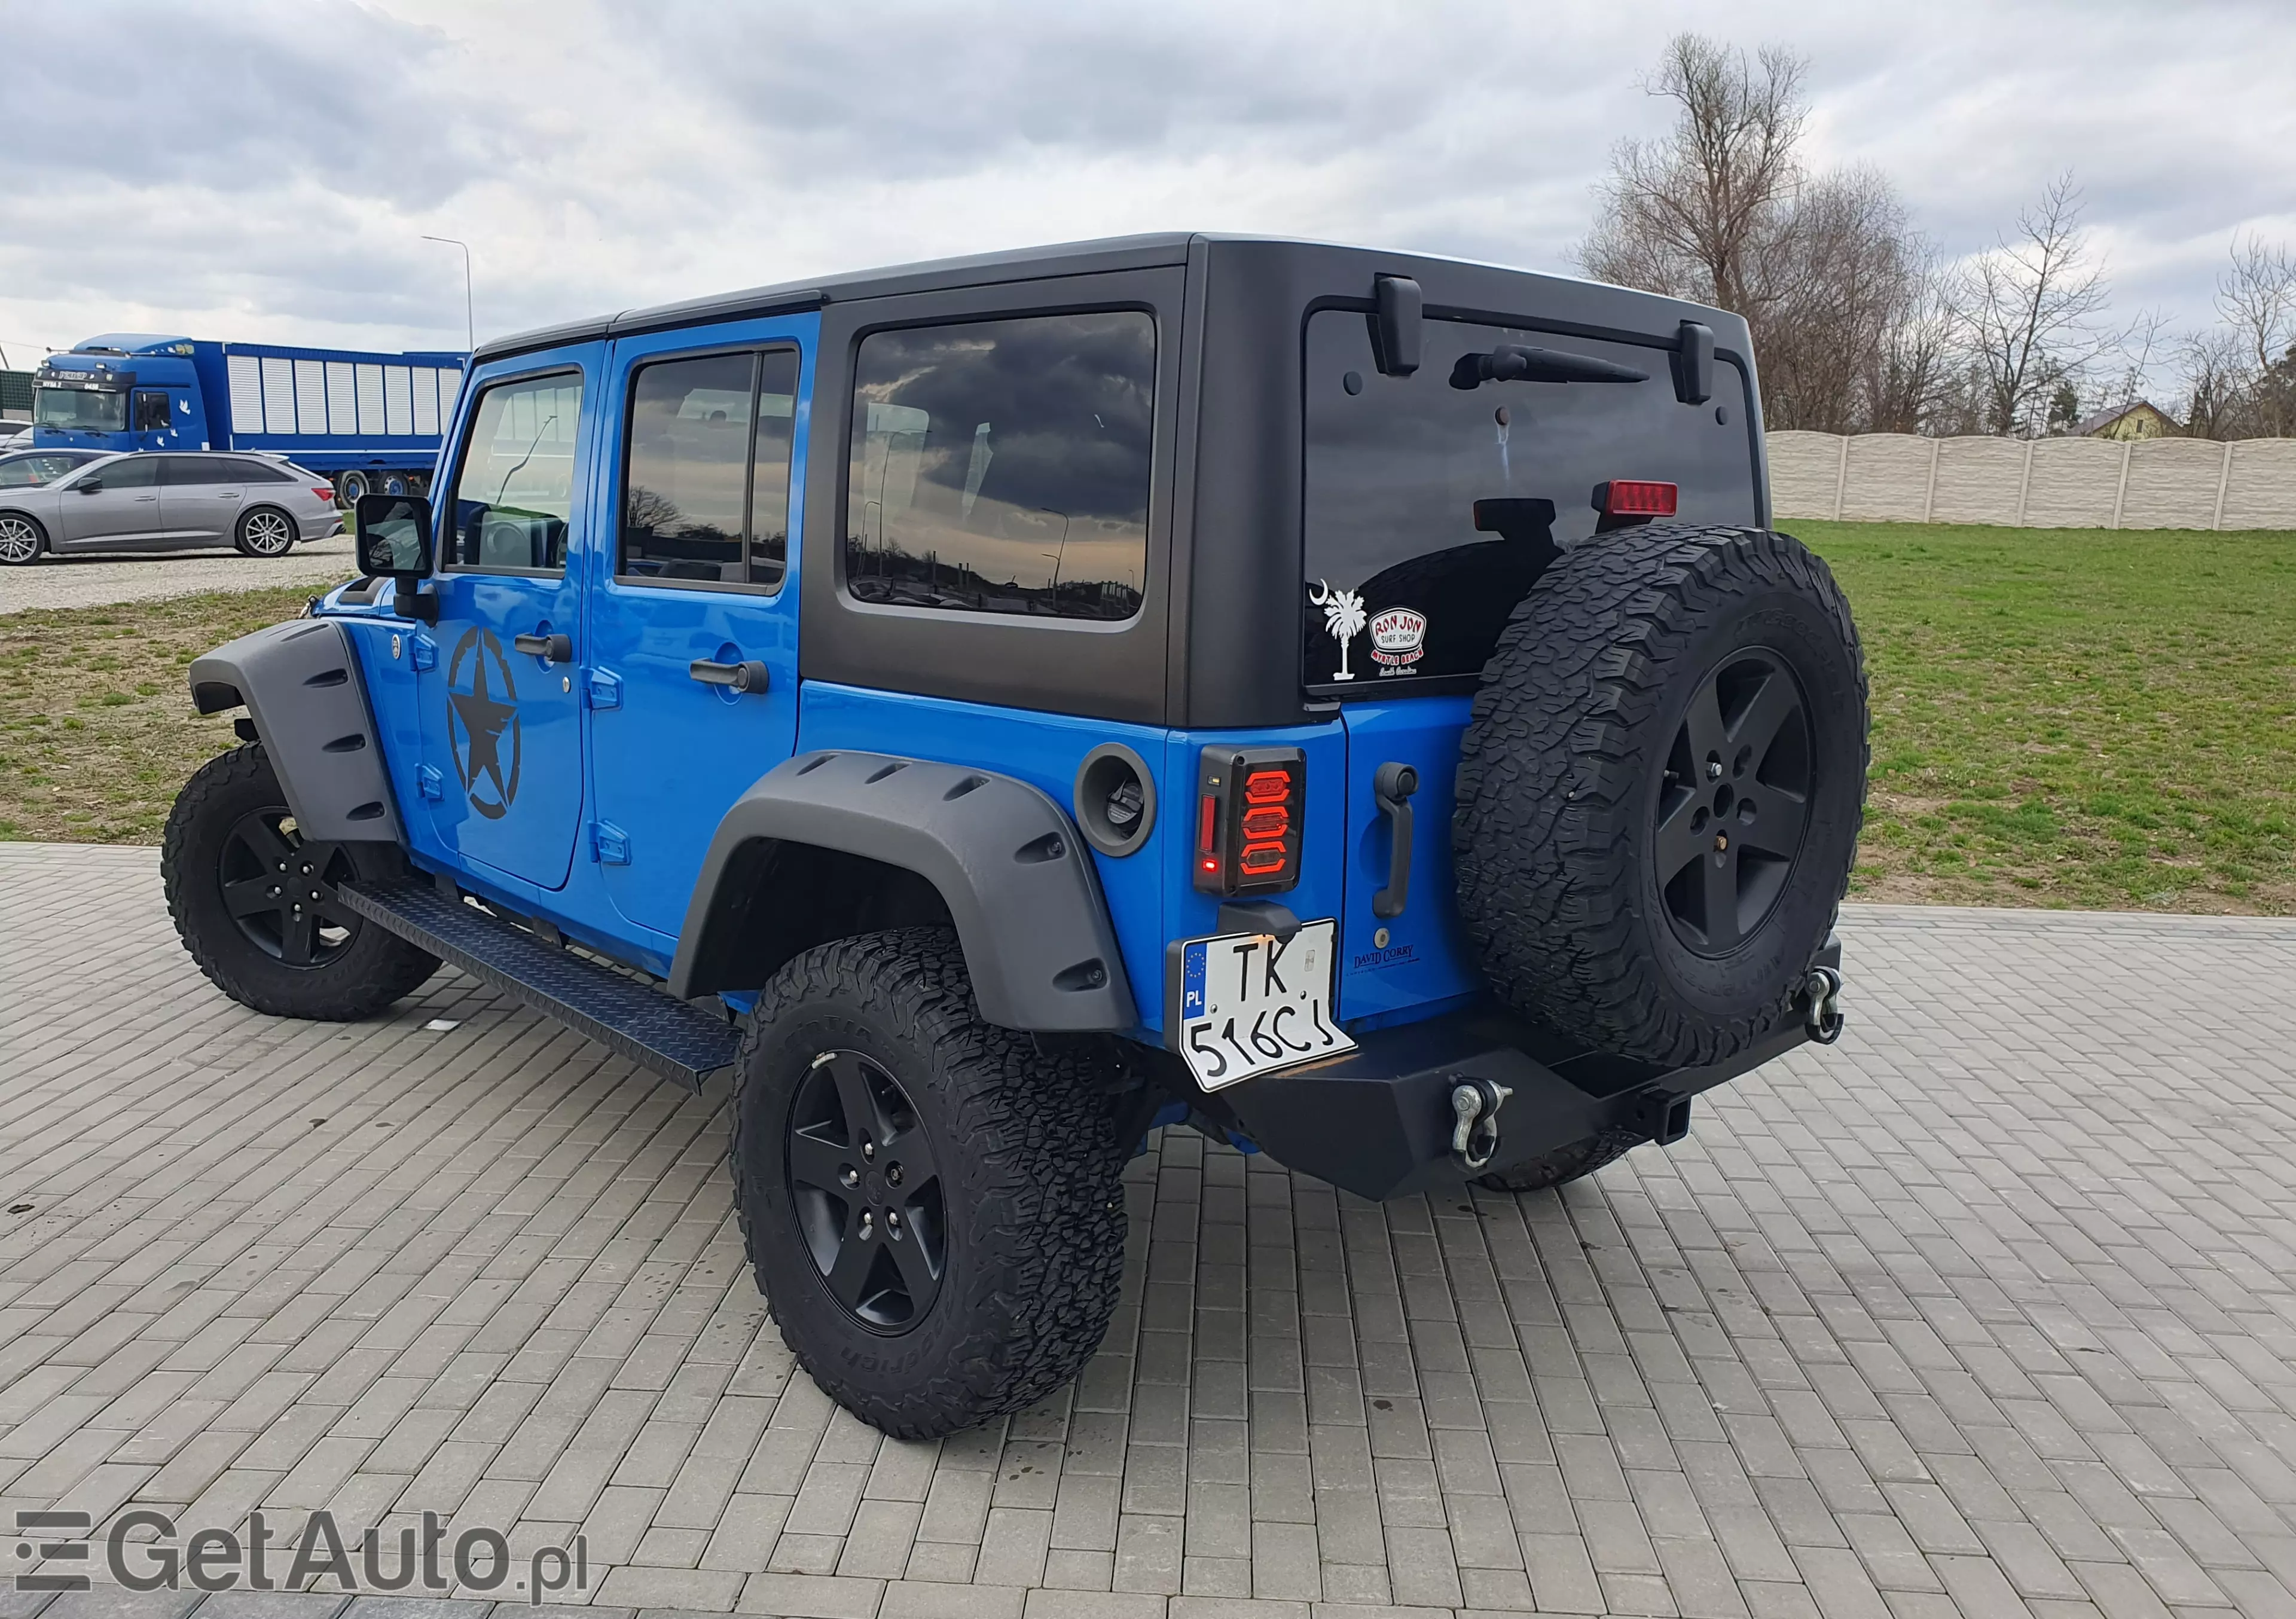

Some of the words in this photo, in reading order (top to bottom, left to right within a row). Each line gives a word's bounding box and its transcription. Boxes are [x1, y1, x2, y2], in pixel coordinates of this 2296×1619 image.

[1375, 615, 1397, 636] RON
[1400, 616, 1422, 633] JON
[1381, 634, 1397, 643] SURF
[1399, 634, 1415, 643] SHOP
[1371, 649, 1399, 665] MYRTLE
[1401, 649, 1424, 665] BEACH
[1354, 952, 1381, 969] DAVID
[1233, 940, 1287, 1001] TK
[1186, 991, 1202, 1007] PL
[1191, 999, 1334, 1077] 516CJ
